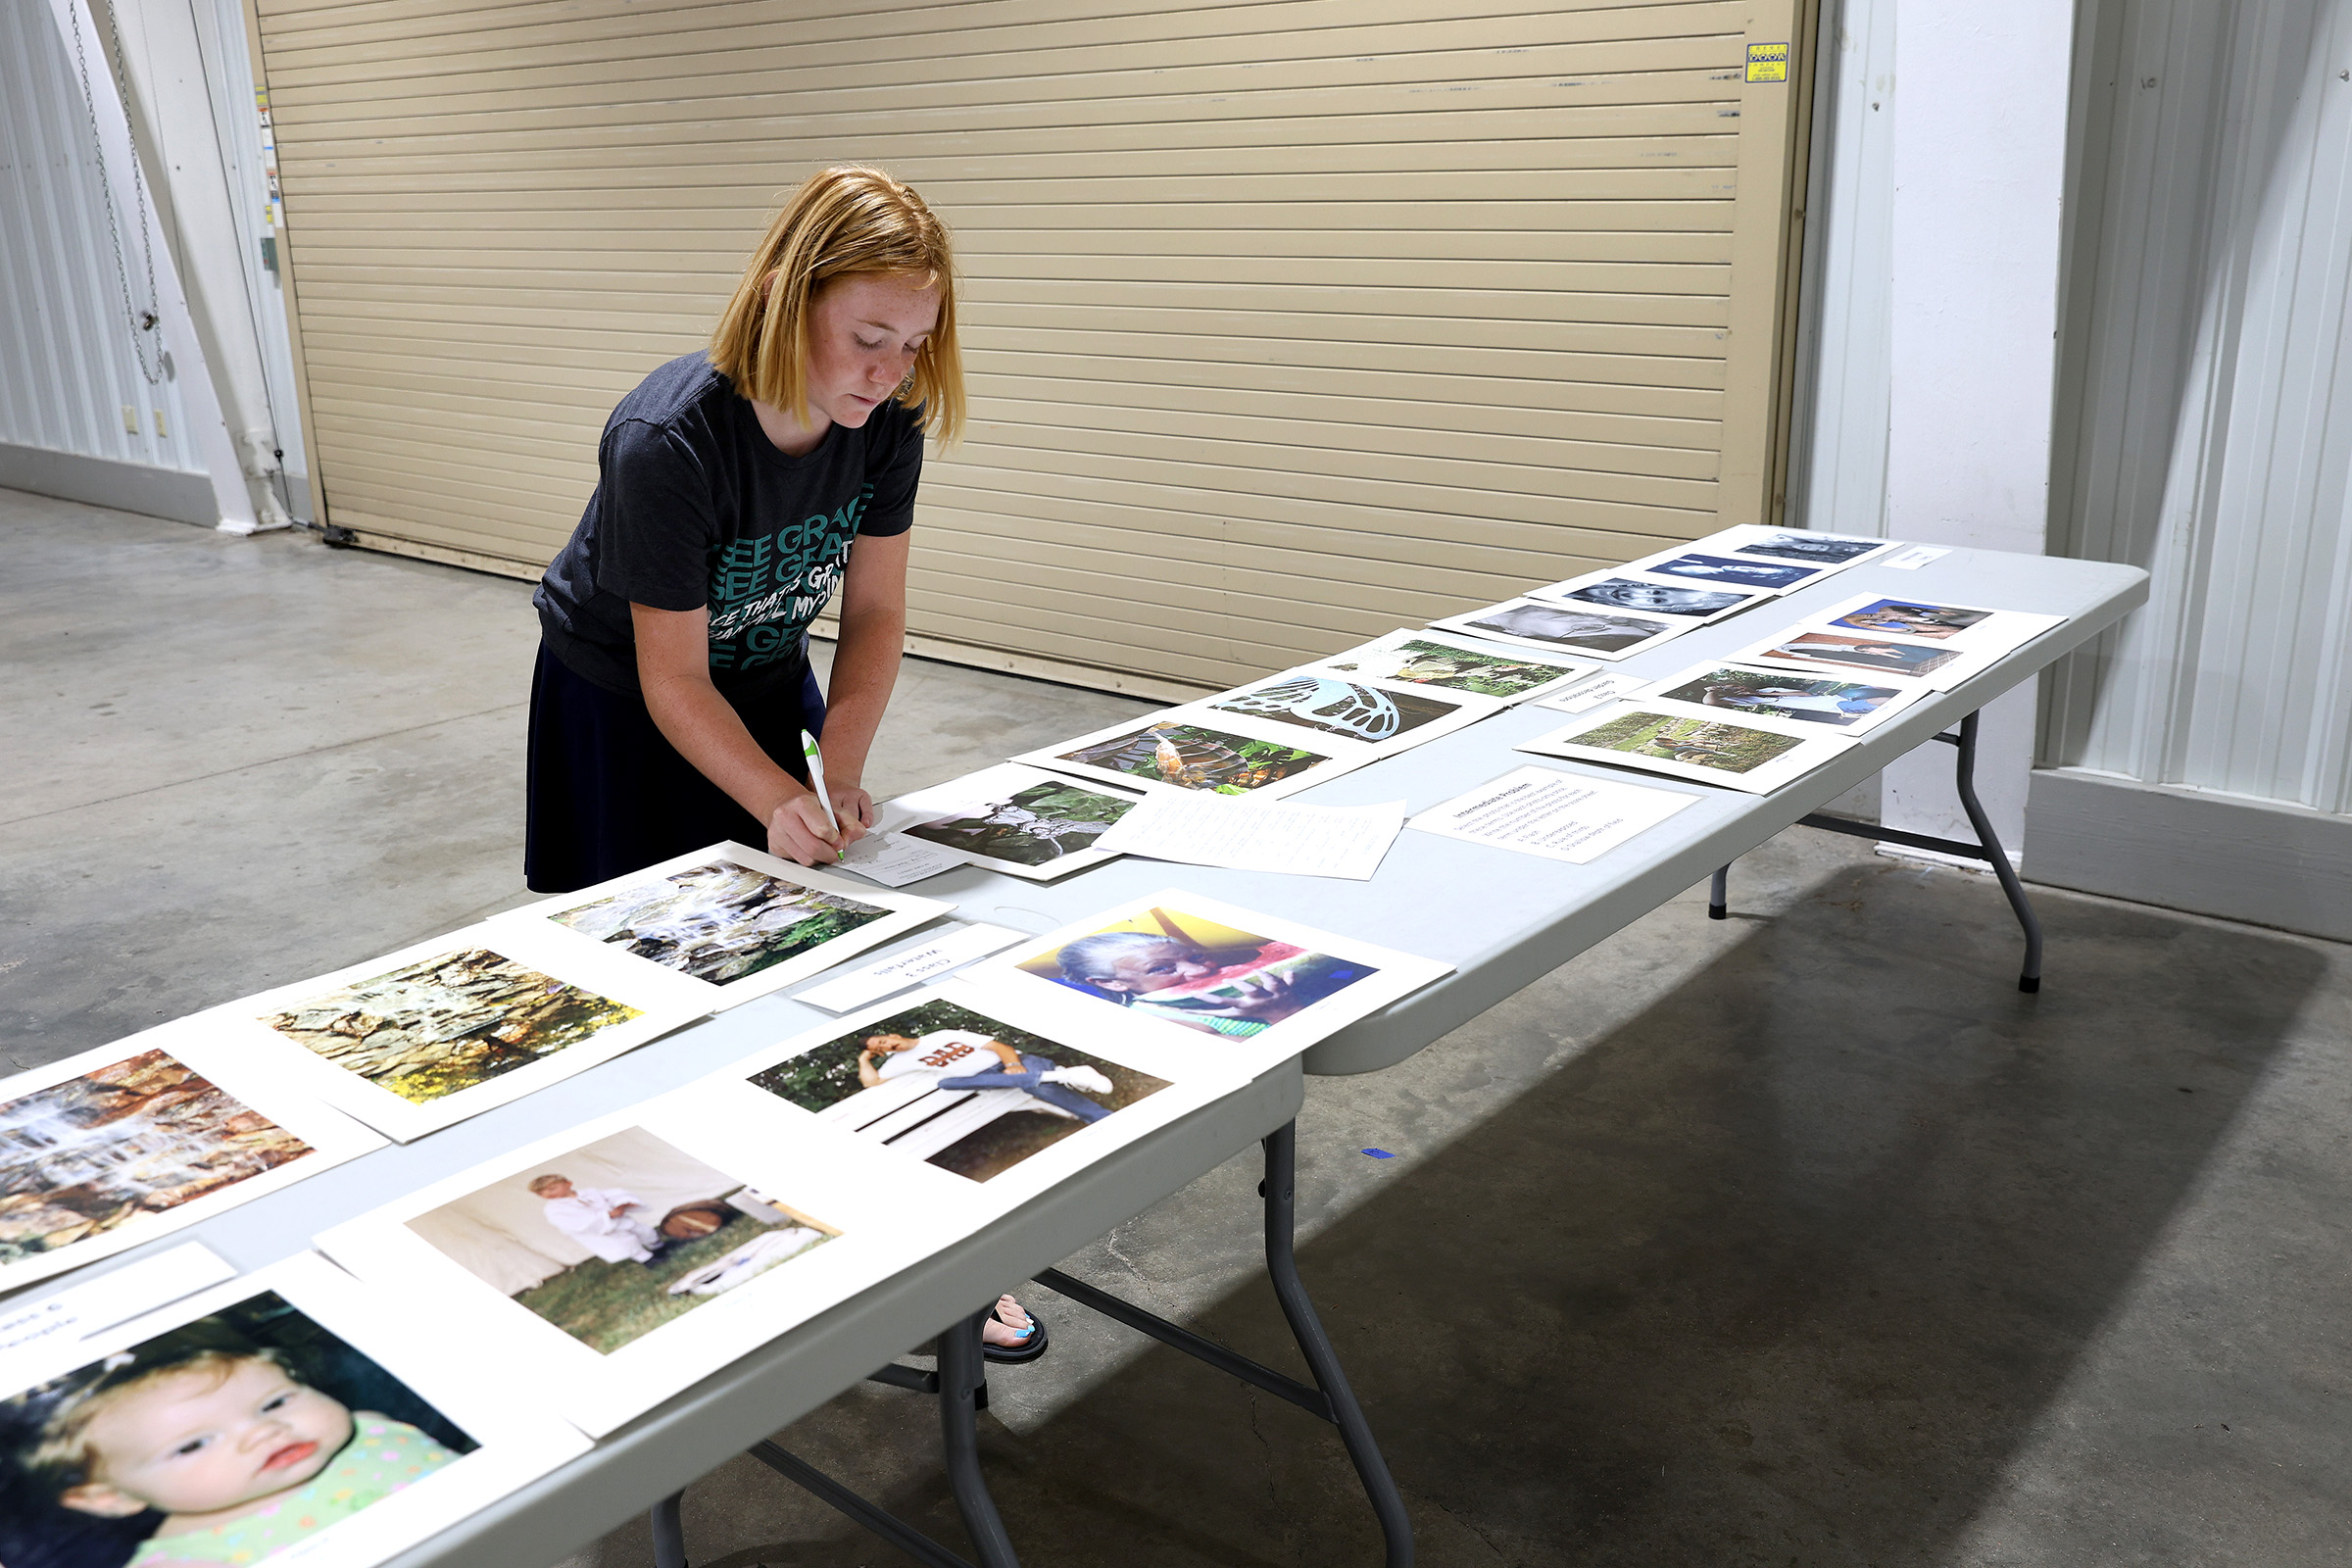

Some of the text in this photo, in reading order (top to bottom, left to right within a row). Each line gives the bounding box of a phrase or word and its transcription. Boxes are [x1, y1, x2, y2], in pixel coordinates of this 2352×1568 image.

[1749, 53, 1787, 63] DOOR
[1452, 782, 1532, 818] Intermediate Problem
